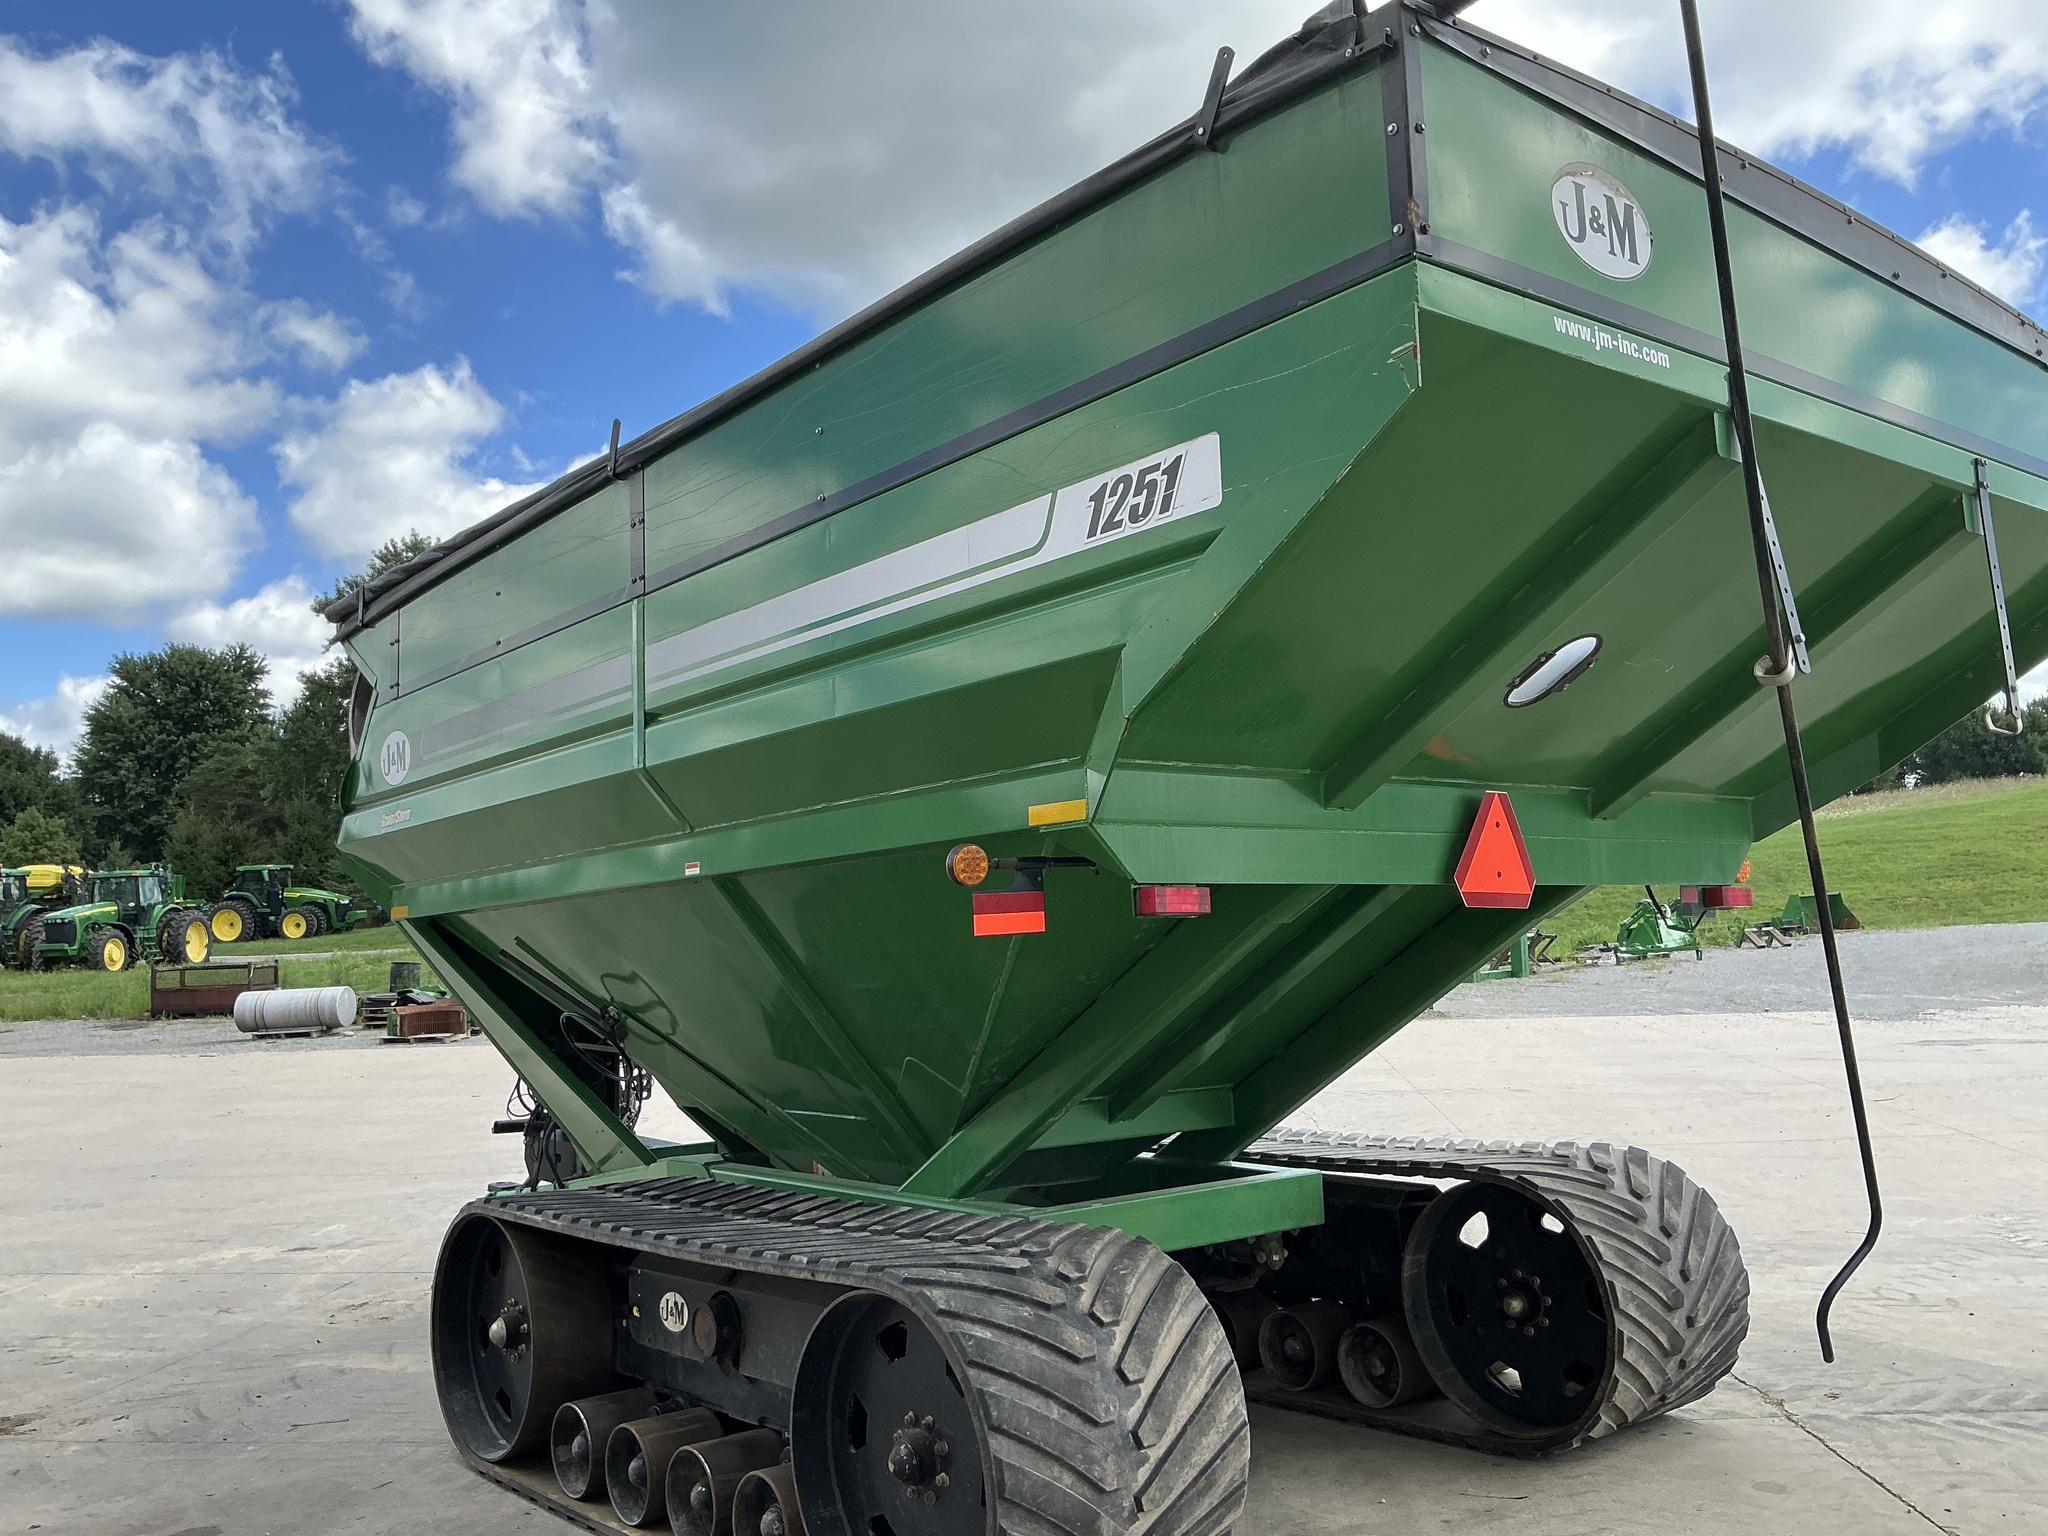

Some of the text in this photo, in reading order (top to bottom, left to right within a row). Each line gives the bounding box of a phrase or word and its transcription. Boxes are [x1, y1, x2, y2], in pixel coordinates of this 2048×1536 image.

[1558, 180, 1641, 266] J&M
[1552, 315, 1671, 369] www.jm-inc.com
[1085, 452, 1185, 541] 1251
[382, 739, 407, 777] J&M
[661, 1298, 685, 1327] J&M
